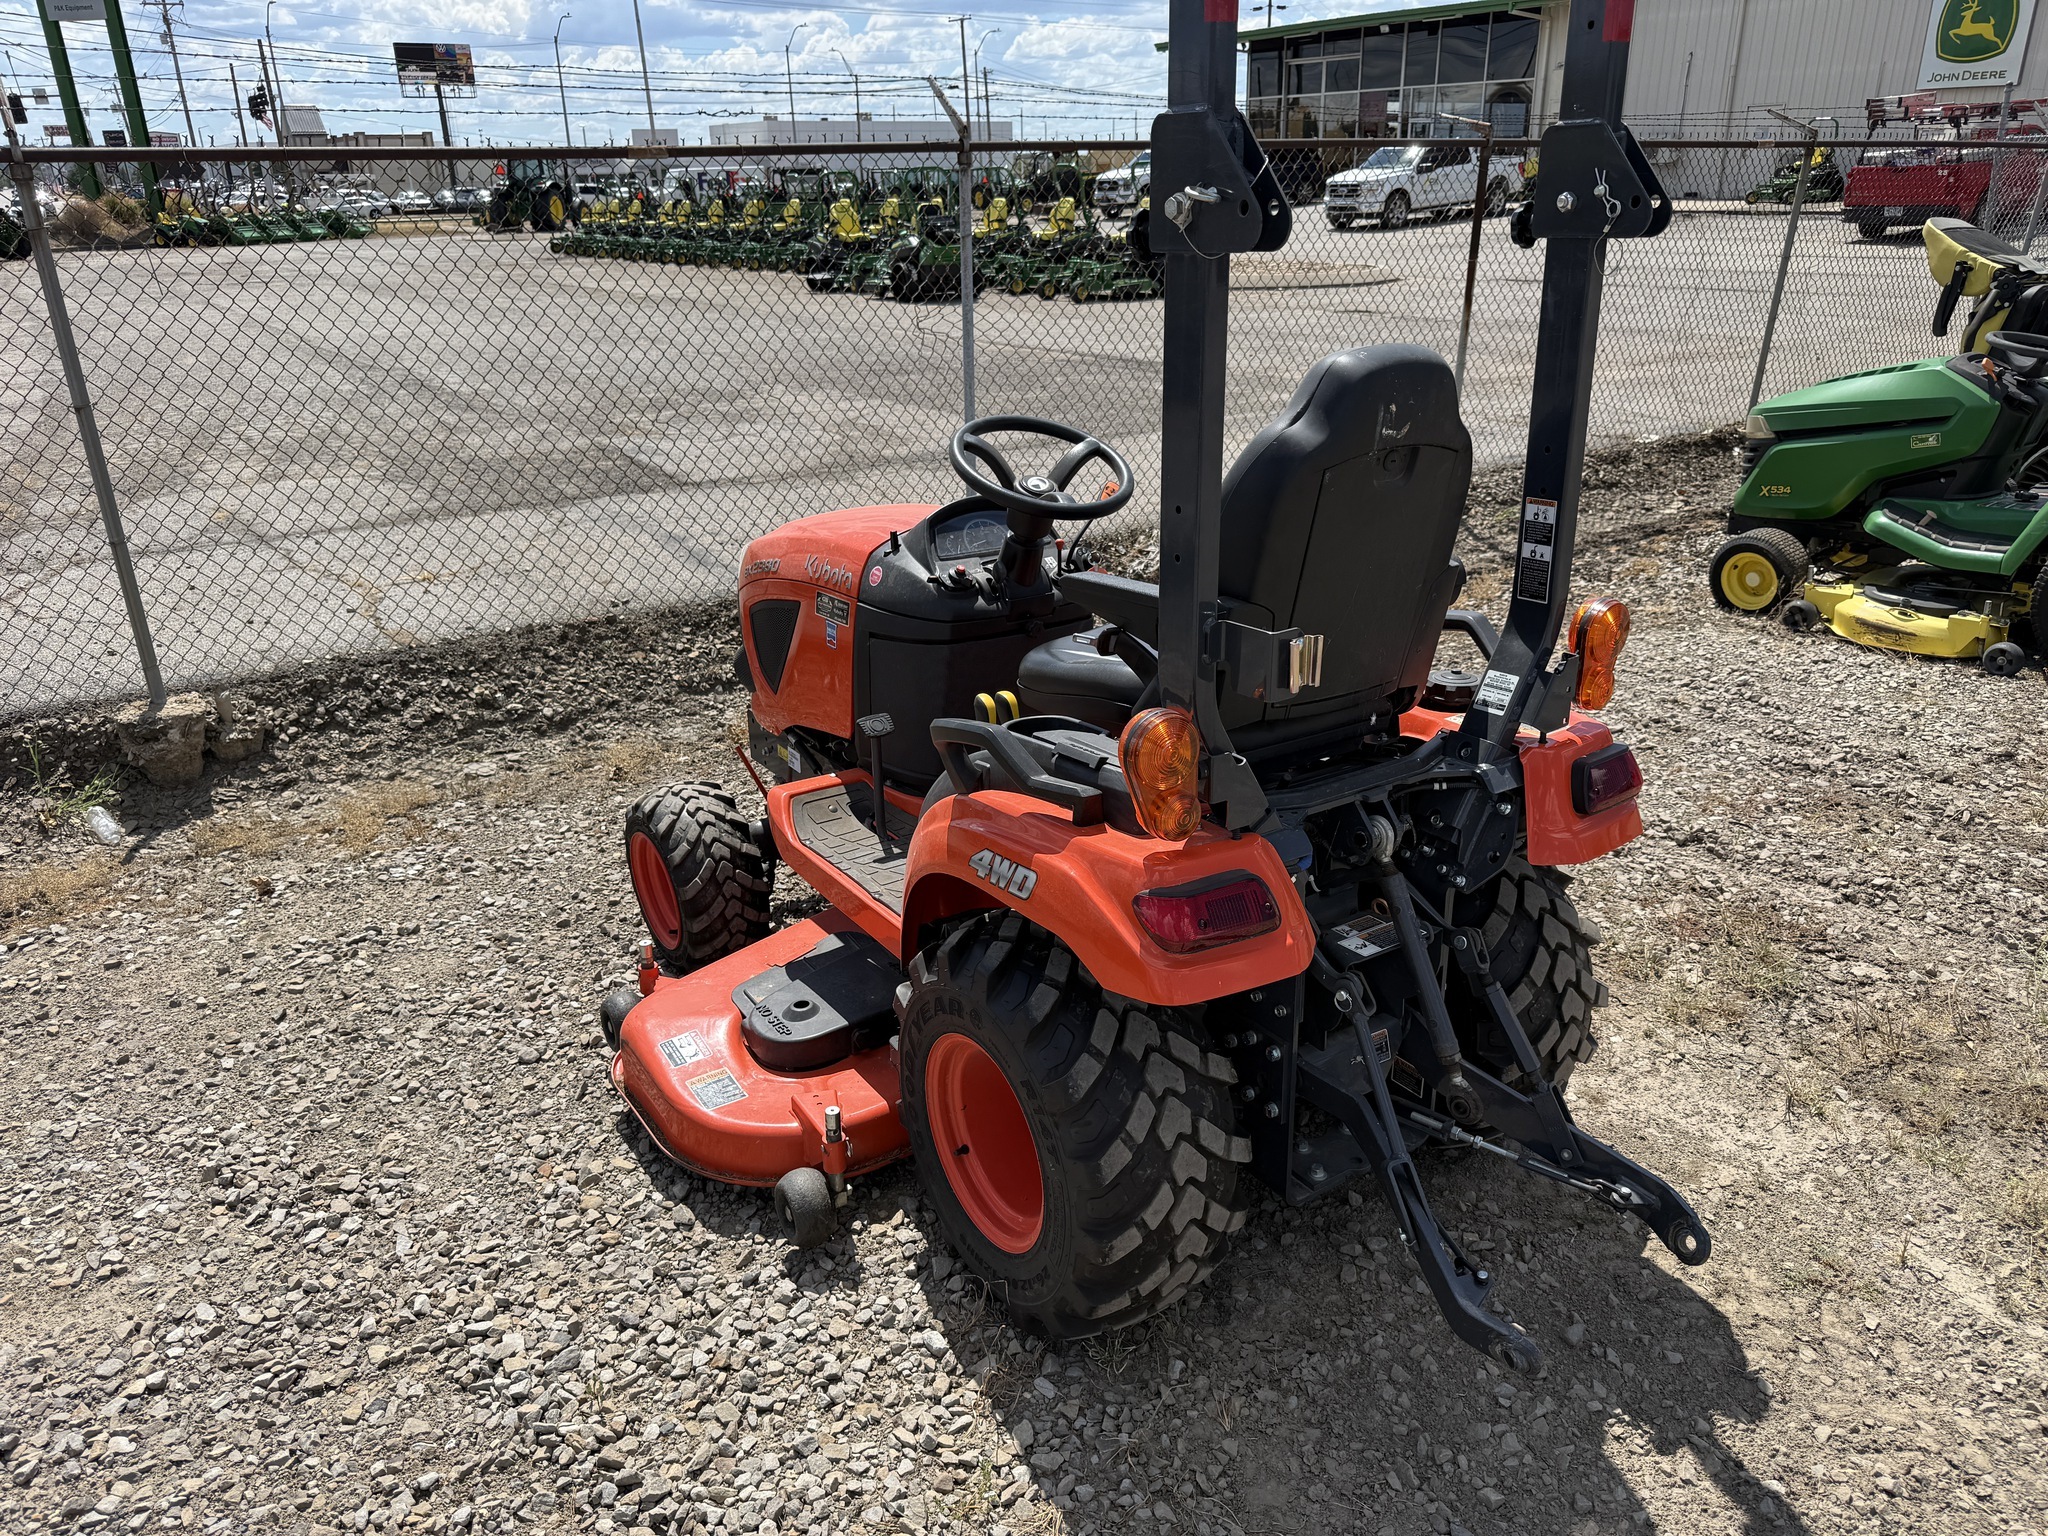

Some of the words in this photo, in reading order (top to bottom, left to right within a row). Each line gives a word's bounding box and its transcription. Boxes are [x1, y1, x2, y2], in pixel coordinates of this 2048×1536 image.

[66, 4, 94, 12] Equipment
[1926, 72, 1960, 83] JOHN
[1961, 70, 2008, 81] DEERE
[1759, 485, 1792, 497] X534
[804, 553, 853, 590] Kubota
[967, 846, 1039, 901] 4WD
[756, 1004, 773, 1018] NO
[767, 1016, 793, 1036] STEP
[696, 1068, 729, 1086] WARNING
